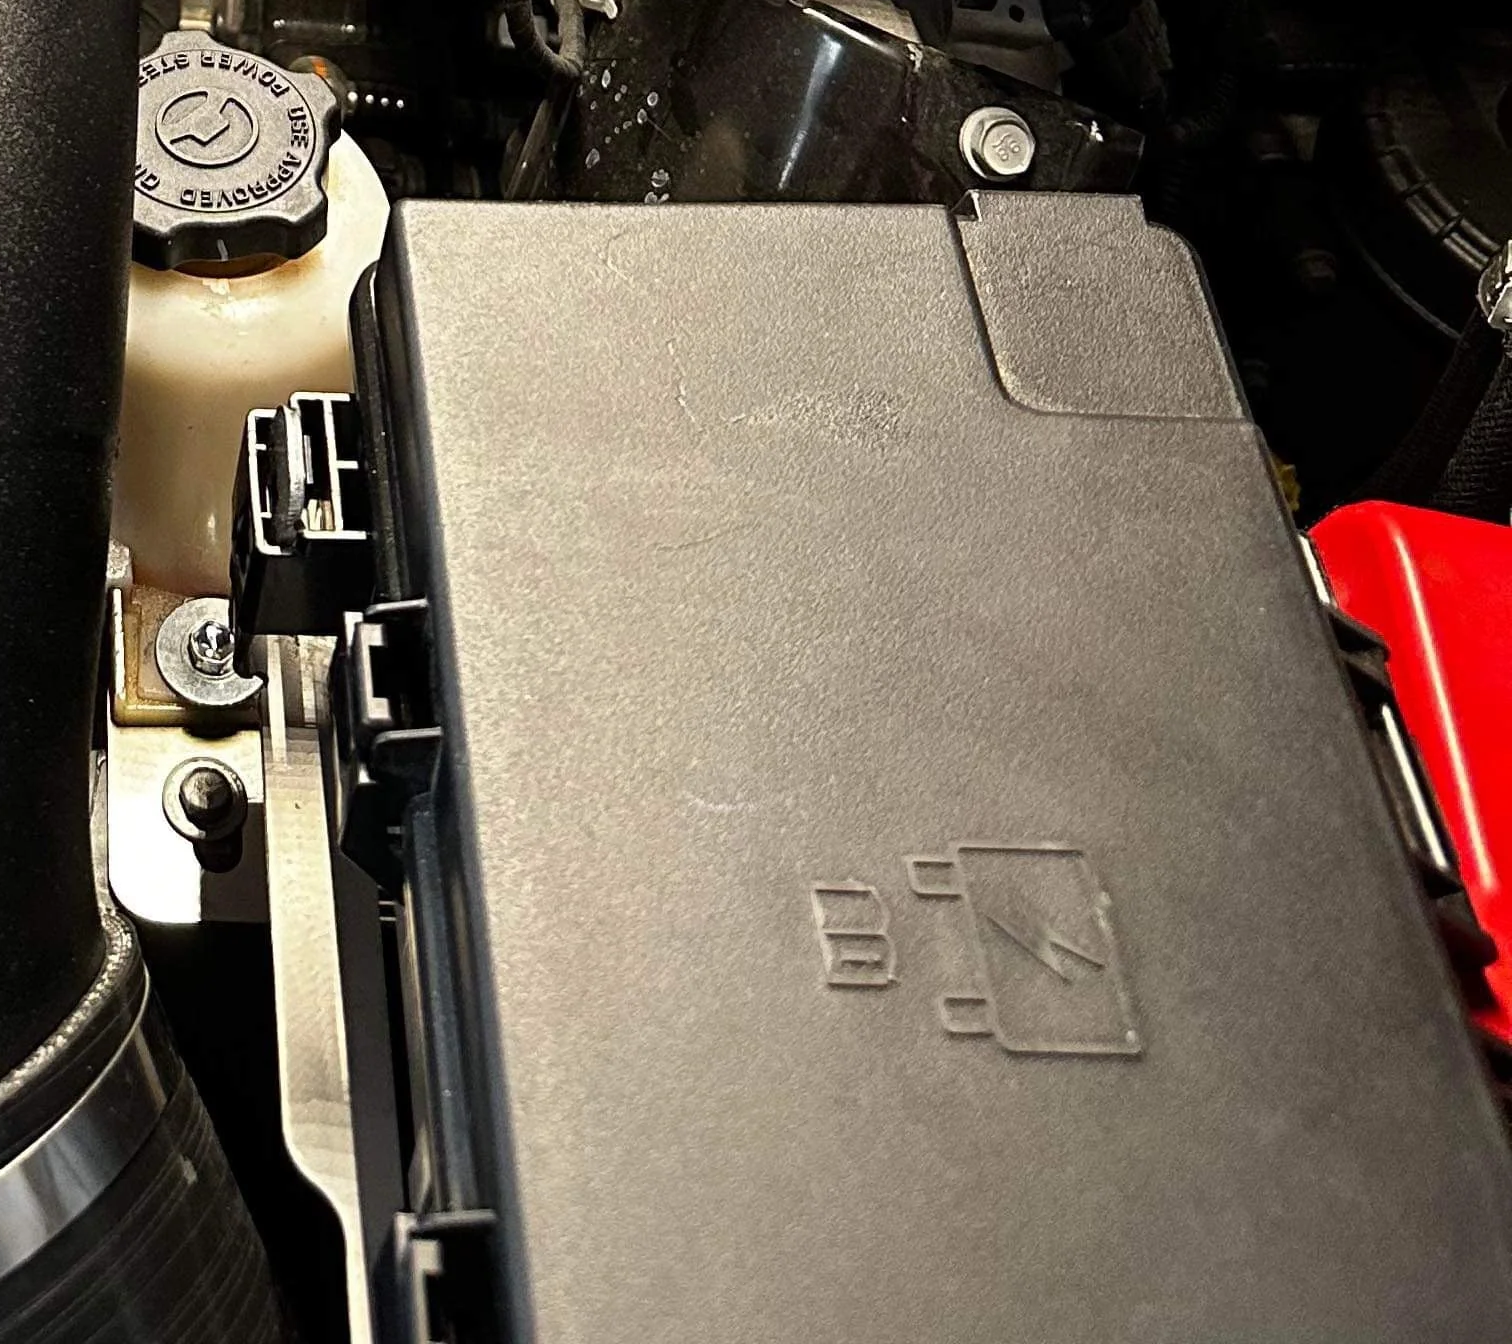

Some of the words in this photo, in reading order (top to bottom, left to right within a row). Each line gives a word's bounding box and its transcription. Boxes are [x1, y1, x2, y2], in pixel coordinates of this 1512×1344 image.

[201, 53, 290, 98] POWER
[288, 106, 309, 149] USE
[180, 152, 302, 209] APPROVED
